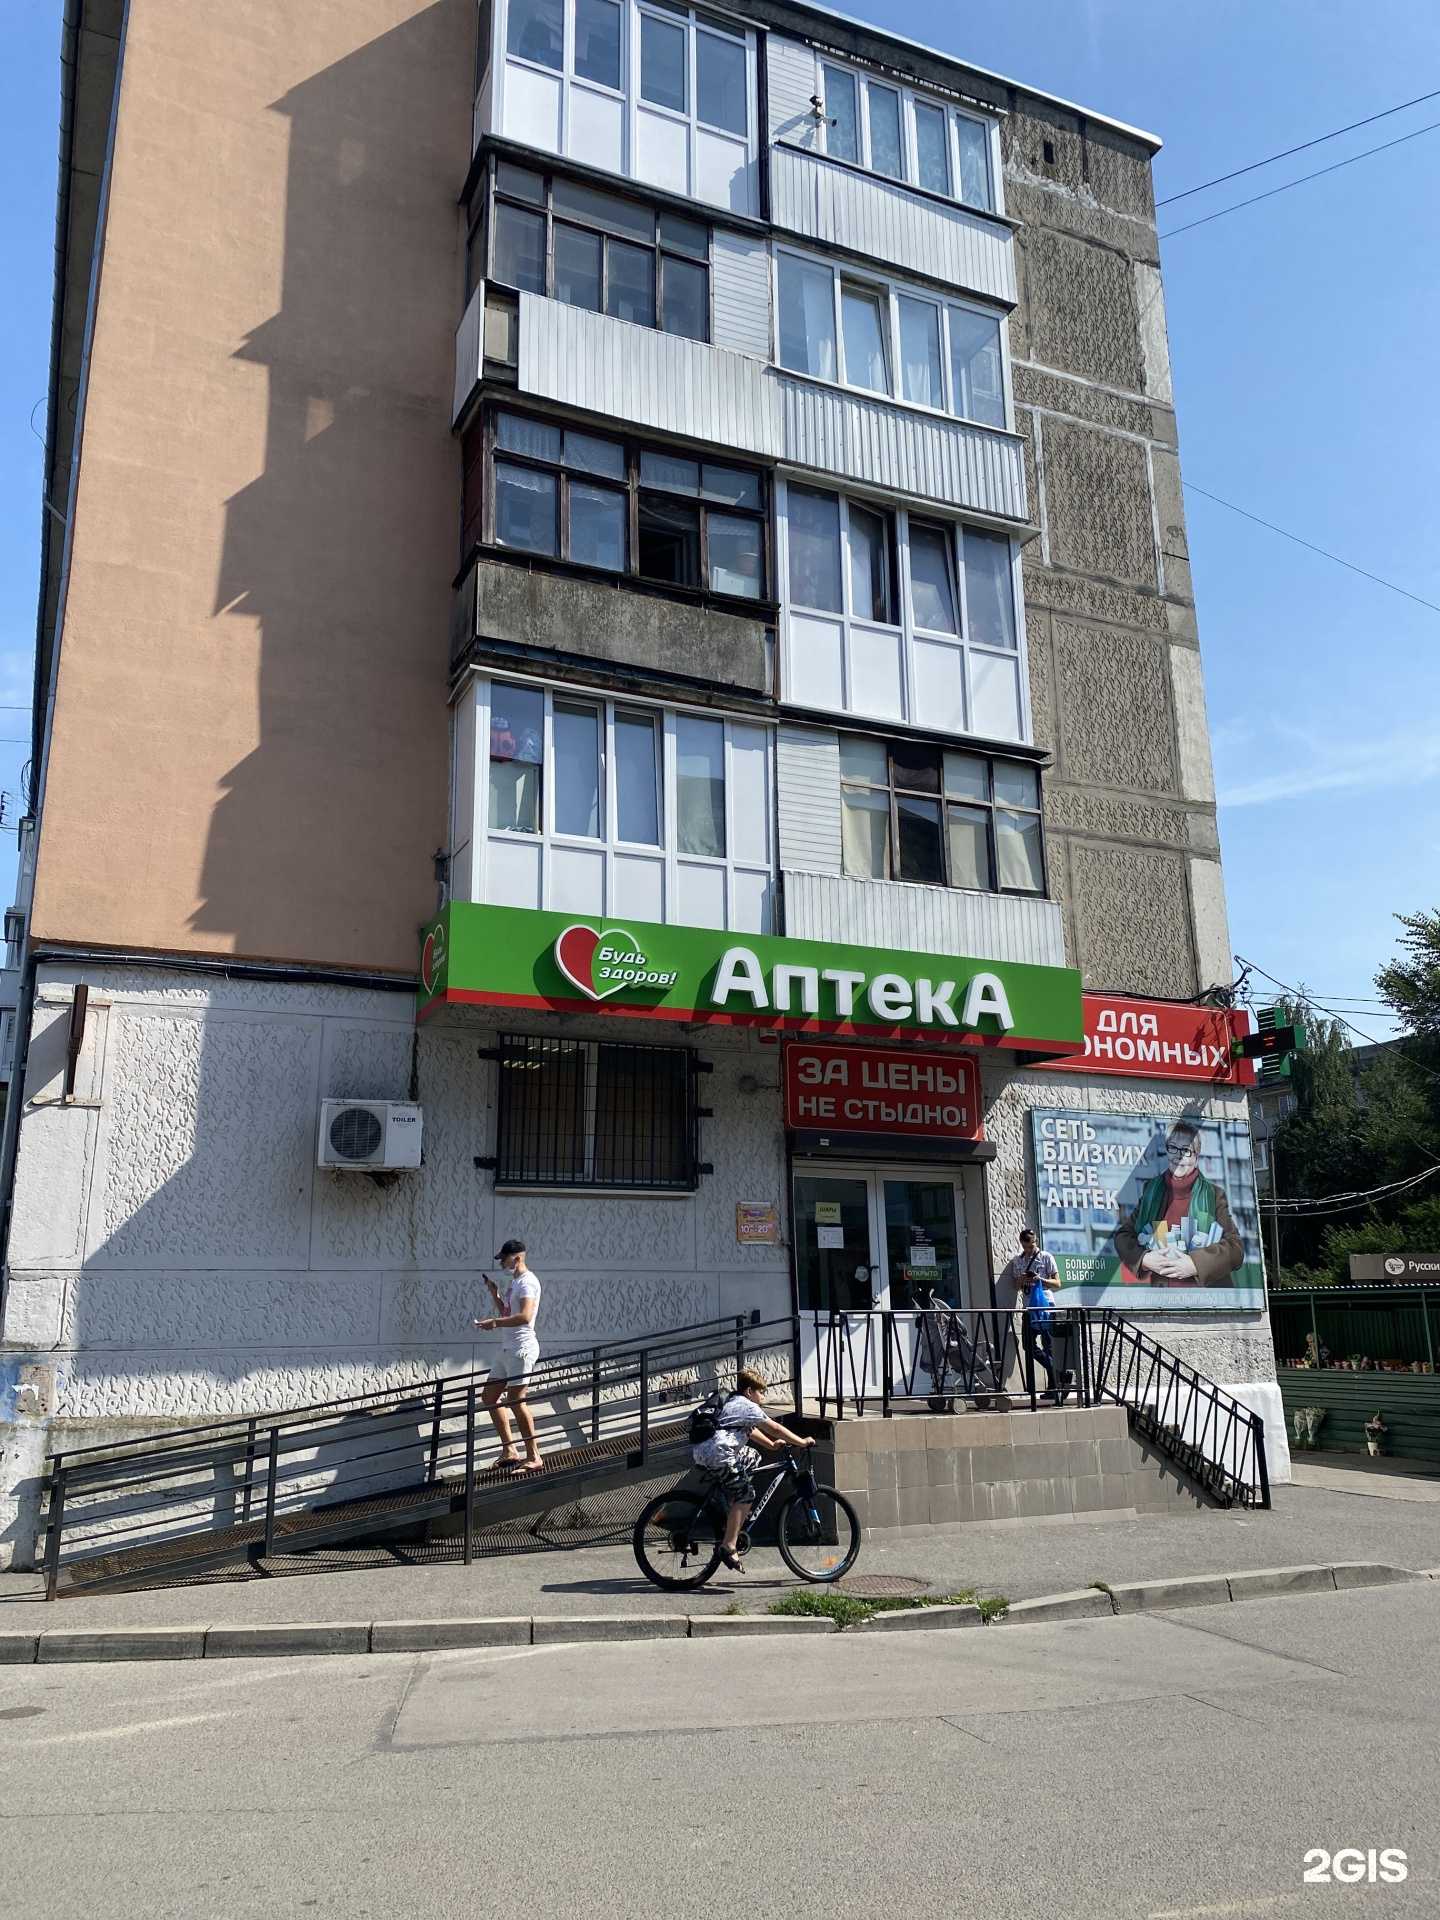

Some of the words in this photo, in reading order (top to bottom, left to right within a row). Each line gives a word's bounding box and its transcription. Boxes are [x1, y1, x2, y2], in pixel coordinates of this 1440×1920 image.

[598, 947, 646, 965] Будь
[599, 967, 677, 985] здоров!
[1097, 1010, 1159, 1036] ДЛЯ
[798, 1057, 849, 1086] ЗА
[861, 1061, 966, 1095] ЦЕНЫ
[798, 1096, 836, 1118] НЕ
[844, 1099, 967, 1127] СТЫДНО!
[1040, 1118, 1096, 1141] СЕТЬ
[1043, 1141, 1148, 1166] БЛИЗКИХ
[1043, 1164, 1099, 1187] ТЕБЕ
[1046, 1187, 1120, 1210] АПТЕК
[1065, 1257, 1106, 1270] БОЛЬШОЙ
[1066, 1270, 1095, 1281] ВЫБОР
